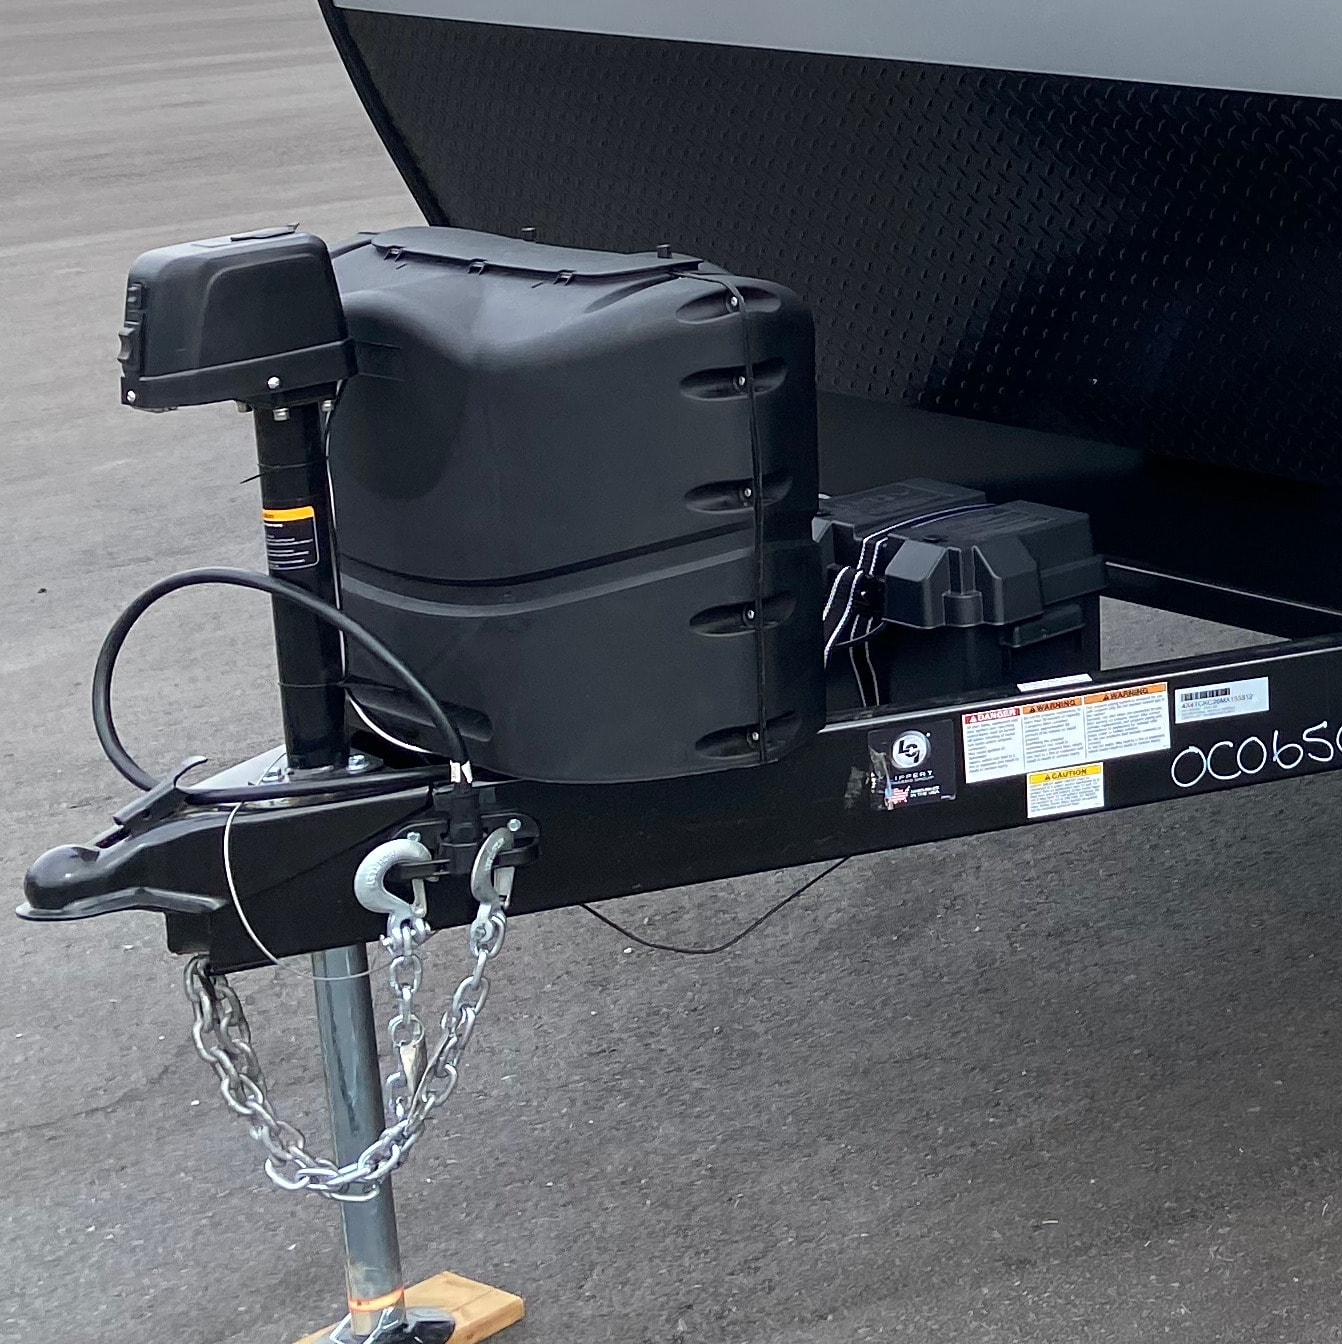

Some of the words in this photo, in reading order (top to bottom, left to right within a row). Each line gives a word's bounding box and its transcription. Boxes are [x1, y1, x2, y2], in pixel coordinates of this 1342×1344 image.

[1109, 686, 1150, 701] WARNING
[1036, 699, 1077, 713] WARNING
[977, 708, 1018, 721] DANGER
[893, 770, 933, 781] IPPERT
[1051, 767, 1087, 780] CAUTION
